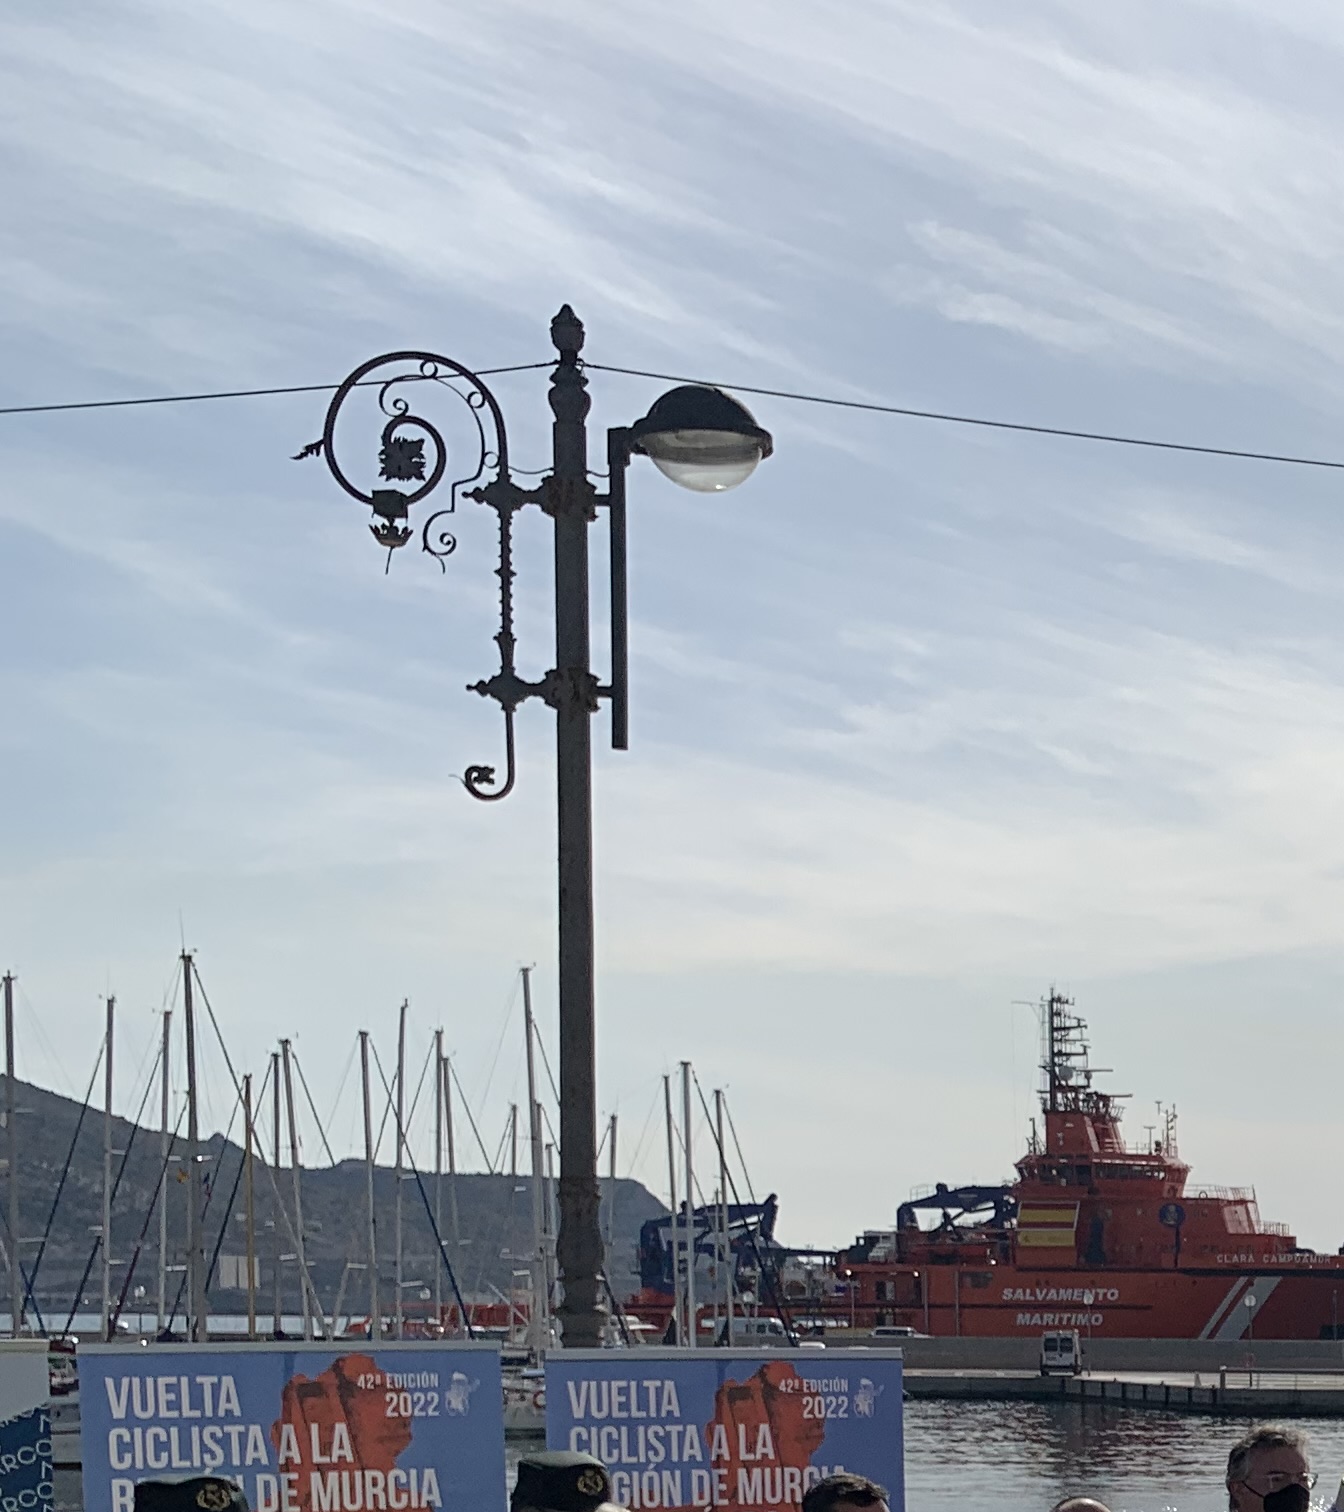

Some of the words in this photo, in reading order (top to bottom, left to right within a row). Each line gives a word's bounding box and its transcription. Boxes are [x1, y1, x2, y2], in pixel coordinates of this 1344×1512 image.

[1216, 1253, 1255, 1264] CLARA
[1002, 1288, 1119, 1301] SALVAMENTO
[1016, 1313, 1103, 1326] MARITIMO
[386, 1371, 439, 1390] EDICIÓN
[803, 1376, 849, 1393] EDICIÓN
[105, 1375, 241, 1420] VUELTA
[385, 1392, 441, 1418] 2022
[567, 1380, 681, 1419] VUELTA
[802, 1396, 849, 1419] 2022
[108, 1424, 270, 1471] CICLISTA
[278, 1423, 302, 1465] A
[311, 1422, 355, 1465] LA
[569, 1424, 703, 1464] CICLISTA
[711, 1424, 731, 1461] A
[738, 1423, 775, 1461] LA
[309, 1468, 443, 1512] MURCIA
[611, 1464, 683, 1509] GIÓN
[692, 1469, 729, 1507] DE
